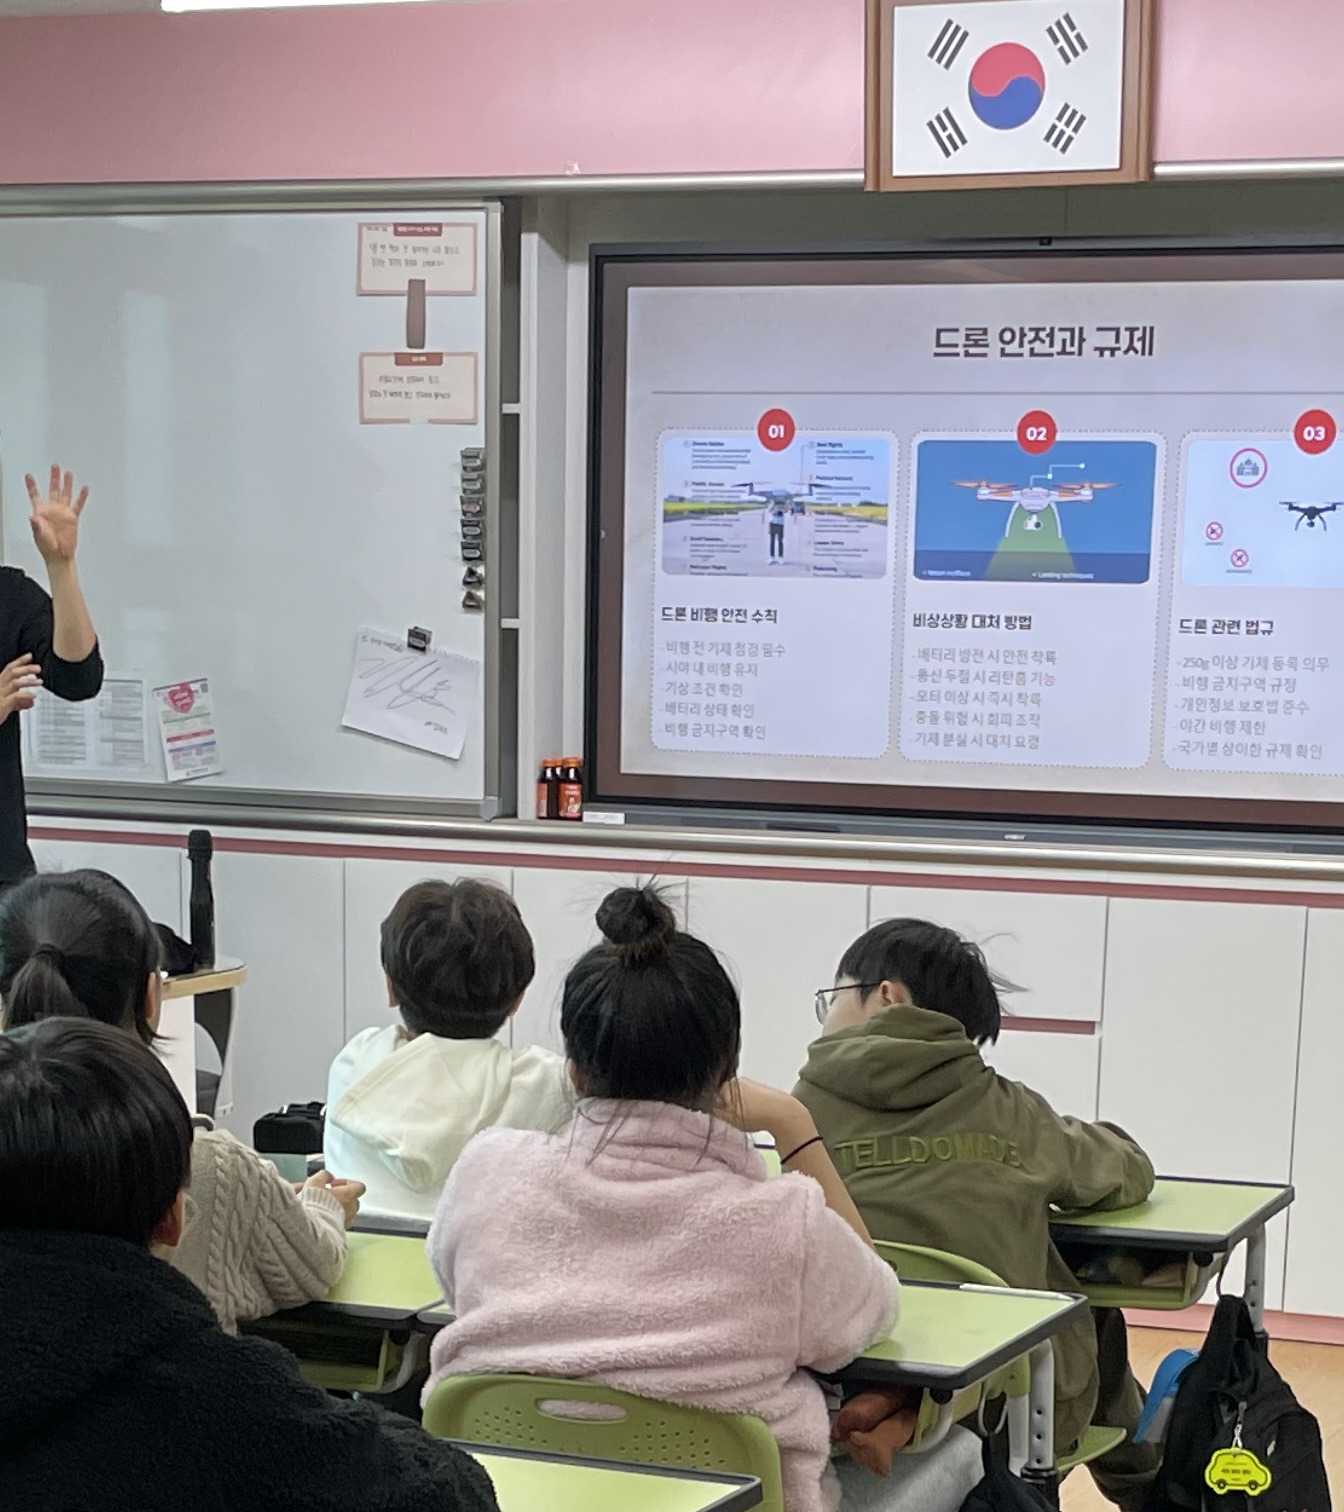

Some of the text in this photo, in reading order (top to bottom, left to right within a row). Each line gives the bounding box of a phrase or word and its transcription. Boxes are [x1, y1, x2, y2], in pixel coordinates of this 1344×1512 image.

[933, 326, 1155, 358] 드론 안전과 규제
[767, 425, 785, 439] 01
[1025, 426, 1047, 441] 02
[1303, 426, 1326, 441] 03
[661, 606, 778, 624] 드론 비행 안전 수칙
[913, 613, 1032, 631] 비상상황 대처 방법
[1178, 619, 1274, 636] 드론 관련 법규
[917, 648, 956, 664] 배터리
[987, 649, 1000, 664] 시
[1002, 650, 1029, 665] 안전
[1182, 657, 1209, 671] 250g
[1212, 655, 1239, 671] 이상
[1272, 656, 1298, 672] 등록
[1302, 657, 1330, 673] 의무
[973, 670, 986, 685] 시
[1030, 672, 1056, 687] 기능
[1182, 676, 1297, 693] 비행 금지구역 규정
[944, 690, 969, 705] 이상
[972, 691, 985, 705] 시
[1180, 697, 1310, 715] 개인정보 보호법 준수
[971, 712, 984, 727] 시
[1179, 718, 1266, 736] 야간 비행 제한
[970, 733, 983, 748] 시
[1178, 740, 1323, 760] 국가별 상이한 규제 확인
